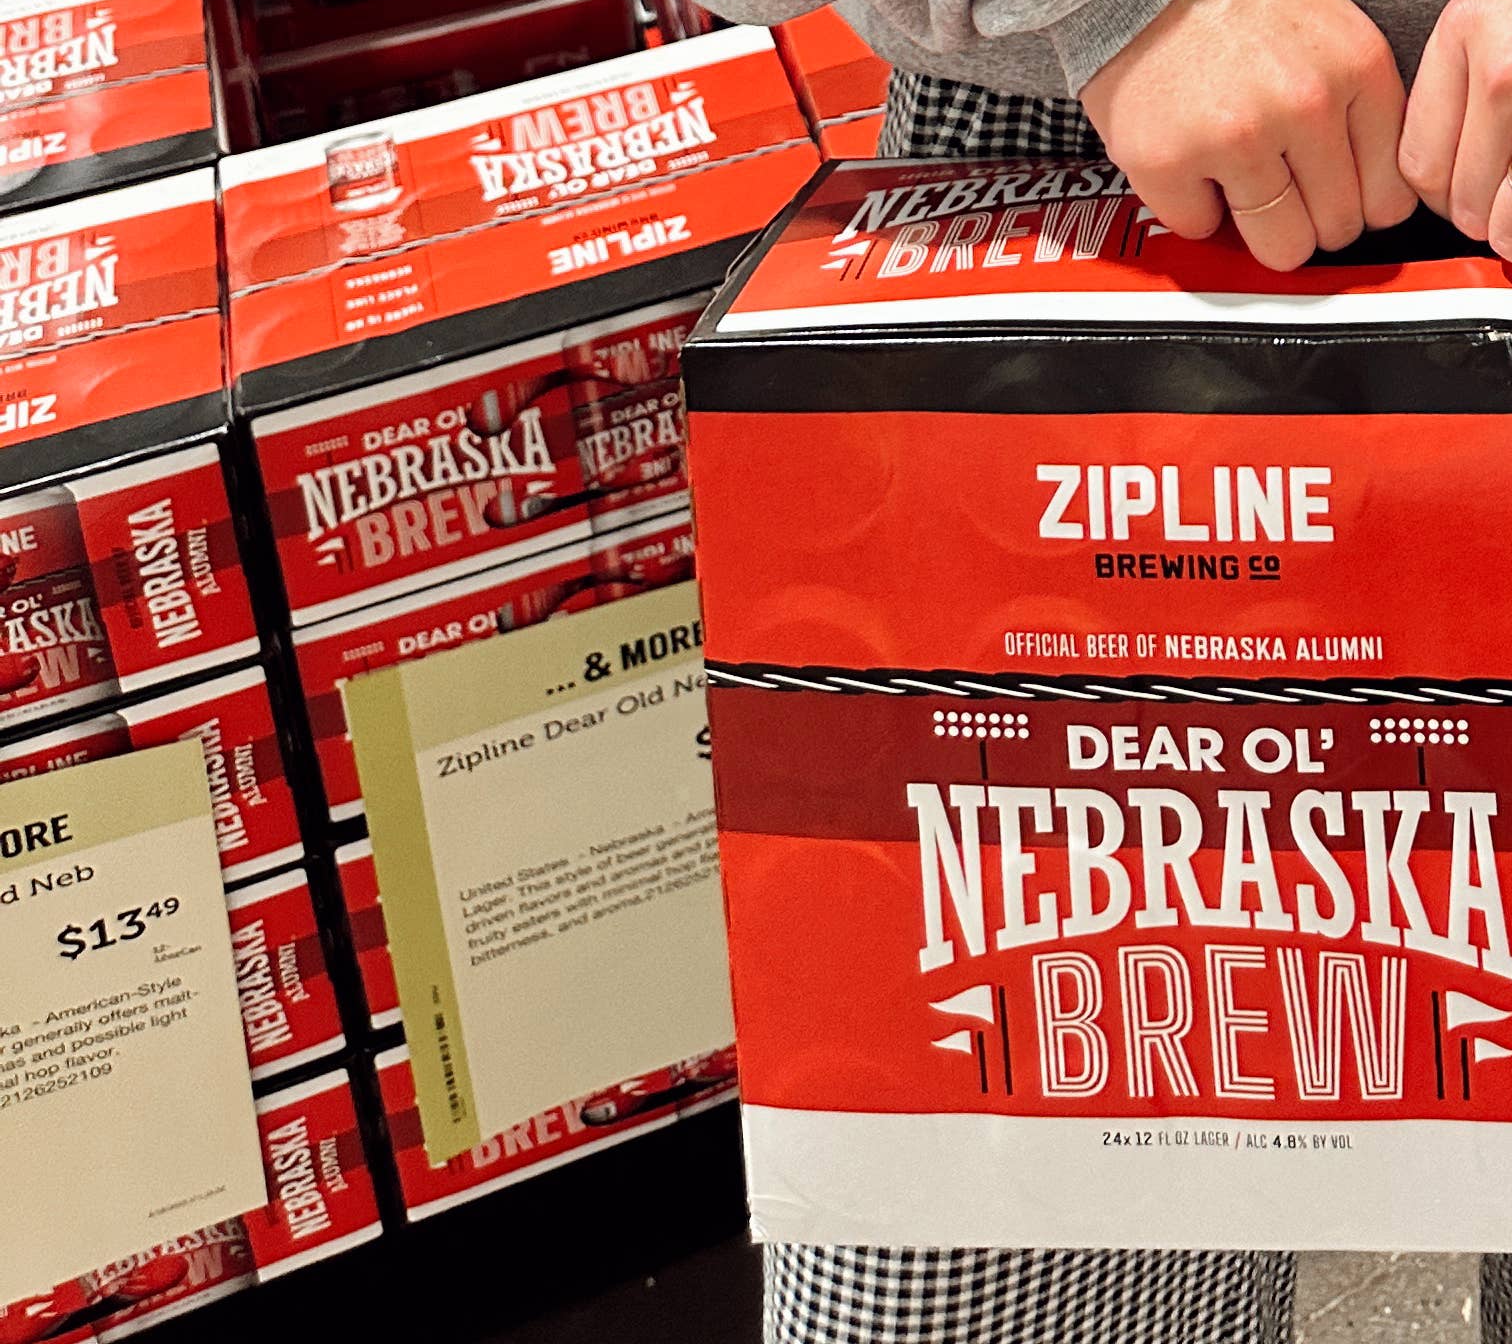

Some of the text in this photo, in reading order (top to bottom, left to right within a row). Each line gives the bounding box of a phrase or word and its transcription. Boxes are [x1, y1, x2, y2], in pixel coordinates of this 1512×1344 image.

[511, 83, 661, 151] BREW
[470, 97, 717, 201] NEBRASKA
[831, 166, 1137, 244] NEBRAS
[548, 215, 692, 275] ZIPLINE
[877, 198, 1123, 279] BREW
[362, 417, 430, 451] DEAR
[297, 405, 556, 542] NEBRASKA
[1036, 463, 1335, 543] ZIPLINE
[128, 497, 203, 649] NEBRASKA
[187, 526, 222, 597] ALUMNI
[1095, 553, 1281, 581] BREWING CO
[0, 596, 105, 657] ASKA
[398, 623, 463, 656] DEAR
[584, 621, 705, 682] & MORE
[1004, 632, 1384, 661] OFFICIAL BEER OF NEBRASKA ALUMNI
[437, 729, 535, 779] Zipline
[544, 707, 609, 742] Dear
[617, 685, 665, 716] Old
[1066, 725, 1335, 775] DEAR OL'
[234, 741, 268, 807] ALUMNI
[31, 865, 96, 898] Neb
[45, 976, 182, 1024] American-Style
[232, 918, 293, 1052] NEBRASKA
[278, 941, 310, 1003] ALUMNI
[12, 1017, 93, 1055] generally
[98, 1003, 150, 1026] offers
[32, 1007, 189, 1064] and possible light
[1031, 943, 1408, 1102] BREW
[25, 1046, 120, 1083] hop flavor.
[319, 1136, 349, 1193] ALUMNI
[1136, 1131, 1152, 1146] 12
[1158, 1132, 1171, 1146] FL
[1175, 1131, 1190, 1145] OZ
[1194, 1131, 1230, 1147] LAGER
[1246, 1134, 1267, 1149] ALC
[1312, 1135, 1326, 1150] BY
[1331, 1134, 1354, 1150] VOL
[268, 1115, 332, 1240] NEBRASKA
